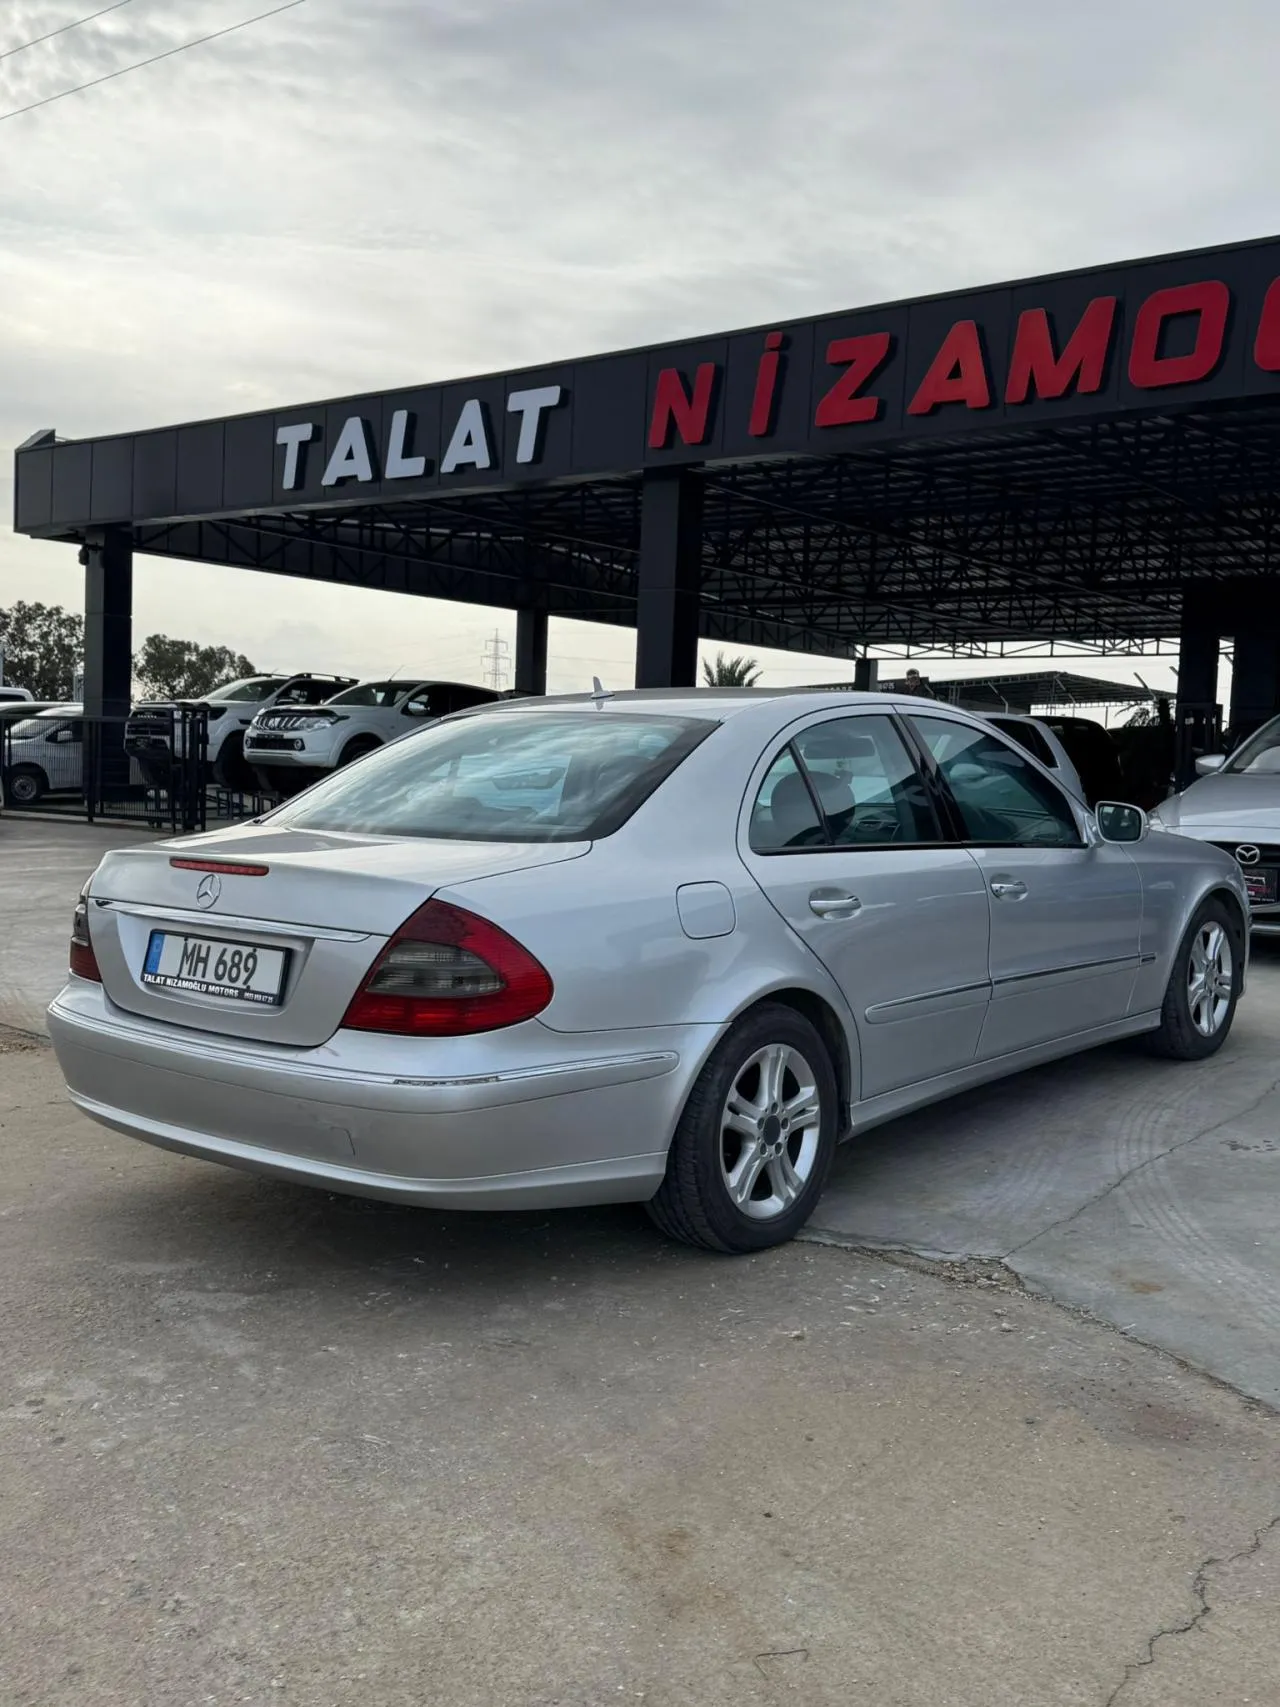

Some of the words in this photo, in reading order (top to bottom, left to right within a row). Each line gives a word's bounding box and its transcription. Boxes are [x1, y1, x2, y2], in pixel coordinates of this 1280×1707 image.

[276, 385, 561, 490] TALAT
[143, 974, 166, 985] TALAT
[208, 985, 239, 998] MOTORS
[180, 941, 211, 978] MH
[213, 947, 258, 986] 689
